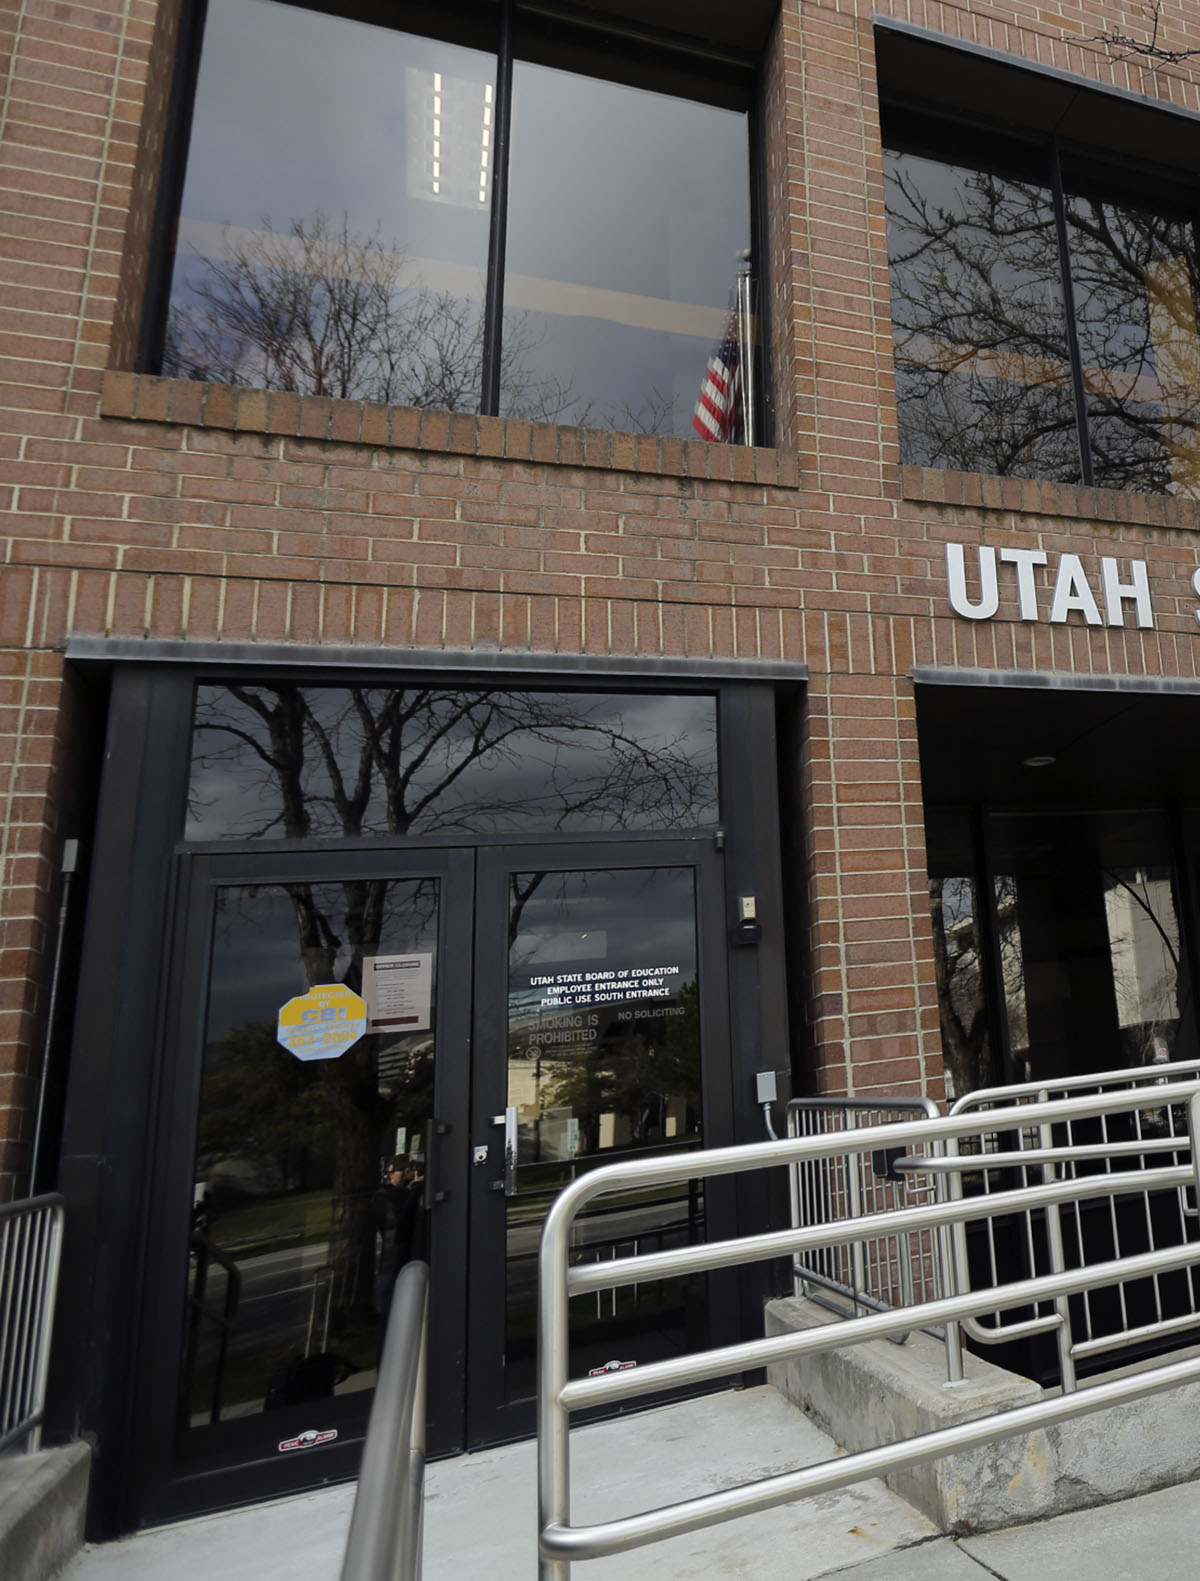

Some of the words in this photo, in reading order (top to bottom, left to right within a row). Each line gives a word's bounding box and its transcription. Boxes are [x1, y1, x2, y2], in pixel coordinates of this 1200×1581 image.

[945, 542, 1154, 628] UTAH
[530, 976, 554, 986] UTAH
[556, 973, 583, 984] STATE
[585, 971, 615, 981] BOARD
[617, 969, 629, 979] OF
[631, 966, 679, 977] EDUCATION
[547, 983, 592, 995] EMPLOYEE
[594, 979, 640, 991] ENTRANCE
[642, 977, 664, 987] ONLY
[541, 996, 573, 1007] PUBLIC
[575, 994, 592, 1004] USE
[594, 991, 624, 1002] SOUTH
[626, 987, 670, 999] ENTRANCE
[302, 1006, 347, 1023] CBI
[528, 1015, 583, 1031] SMOKING
[587, 1013, 599, 1026] IS
[618, 1010, 632, 1020] NO
[634, 1006, 686, 1019] SOLICITING
[528, 1028, 597, 1045] PROHIBITED
